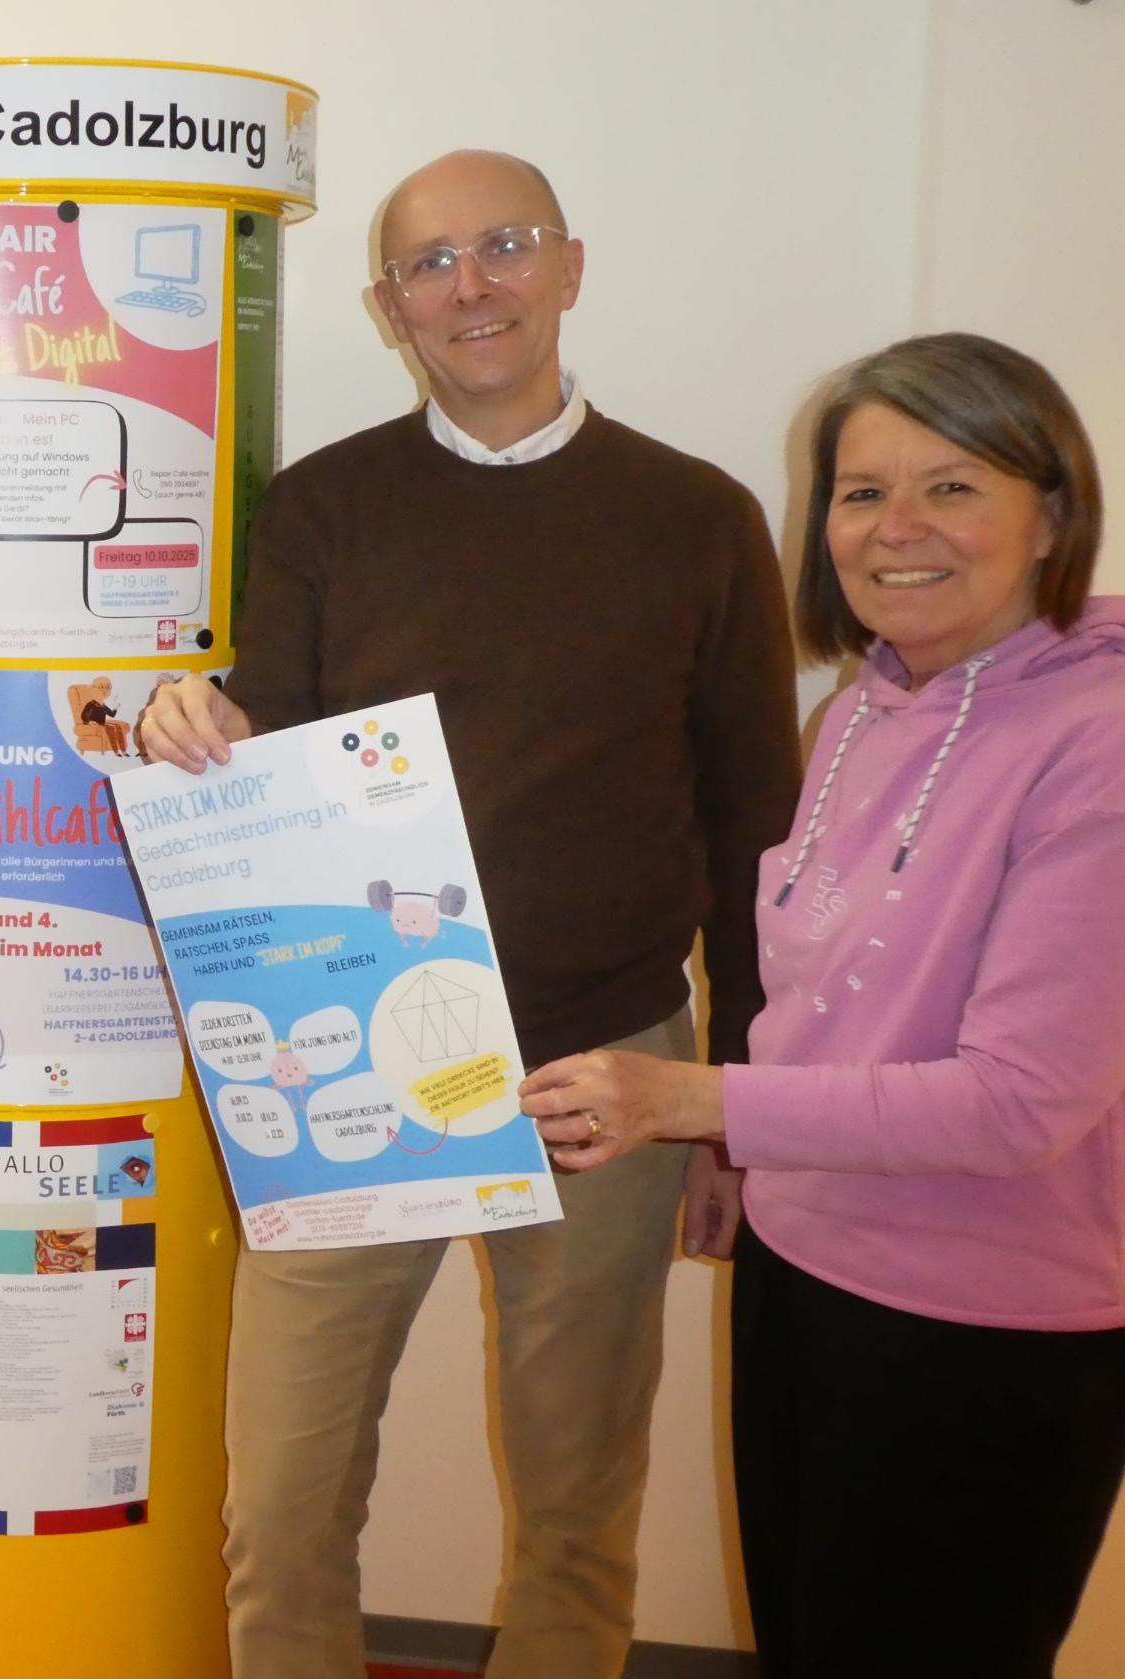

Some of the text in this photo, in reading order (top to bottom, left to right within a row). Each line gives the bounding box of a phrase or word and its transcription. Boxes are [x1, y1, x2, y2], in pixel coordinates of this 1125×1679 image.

[24, 313, 122, 386] Digital
[22, 413, 57, 425] Mein
[60, 413, 80, 426] PC
[33, 433, 53, 446] es!
[21, 452, 40, 462] auf
[42, 452, 90, 462] Windows
[21, 467, 70, 479] gemacht
[98, 549, 196, 566] Freitag 10.10.2025
[140, 575, 168, 588] UHR
[191, 787, 219, 819] IM
[135, 798, 347, 864] Gedächtnistraining in
[0, 855, 22, 867] alle
[23, 856, 91, 870] Bürgerinnen
[92, 857, 115, 868] und
[1, 869, 66, 882] erforderlich
[146, 855, 252, 892] Cadolzburg
[37, 912, 59, 929] 4.
[160, 921, 223, 943] GEMEINSAM
[0, 939, 29, 957] im
[32, 940, 104, 958] Monat
[233, 931, 271, 951] SPASS
[192, 957, 229, 978] HABEN
[230, 954, 256, 972] UND
[296, 941, 315, 960] IM
[325, 952, 377, 975] BLEIBEN
[63, 965, 139, 983] 14.30-16
[200, 1012, 254, 1031] JEDEN DRITTEN
[98, 1029, 179, 1043] CADOLZBURG
[198, 1031, 268, 1052] DIENSTAG IM MONAT
[307, 1035, 328, 1049] JUNG
[327, 1033, 343, 1046] UND
[334, 1122, 379, 1139] CADOLZBURG
[38, 1173, 121, 1198] SEELE
[41, 1281, 84, 1293] Gesundheit
